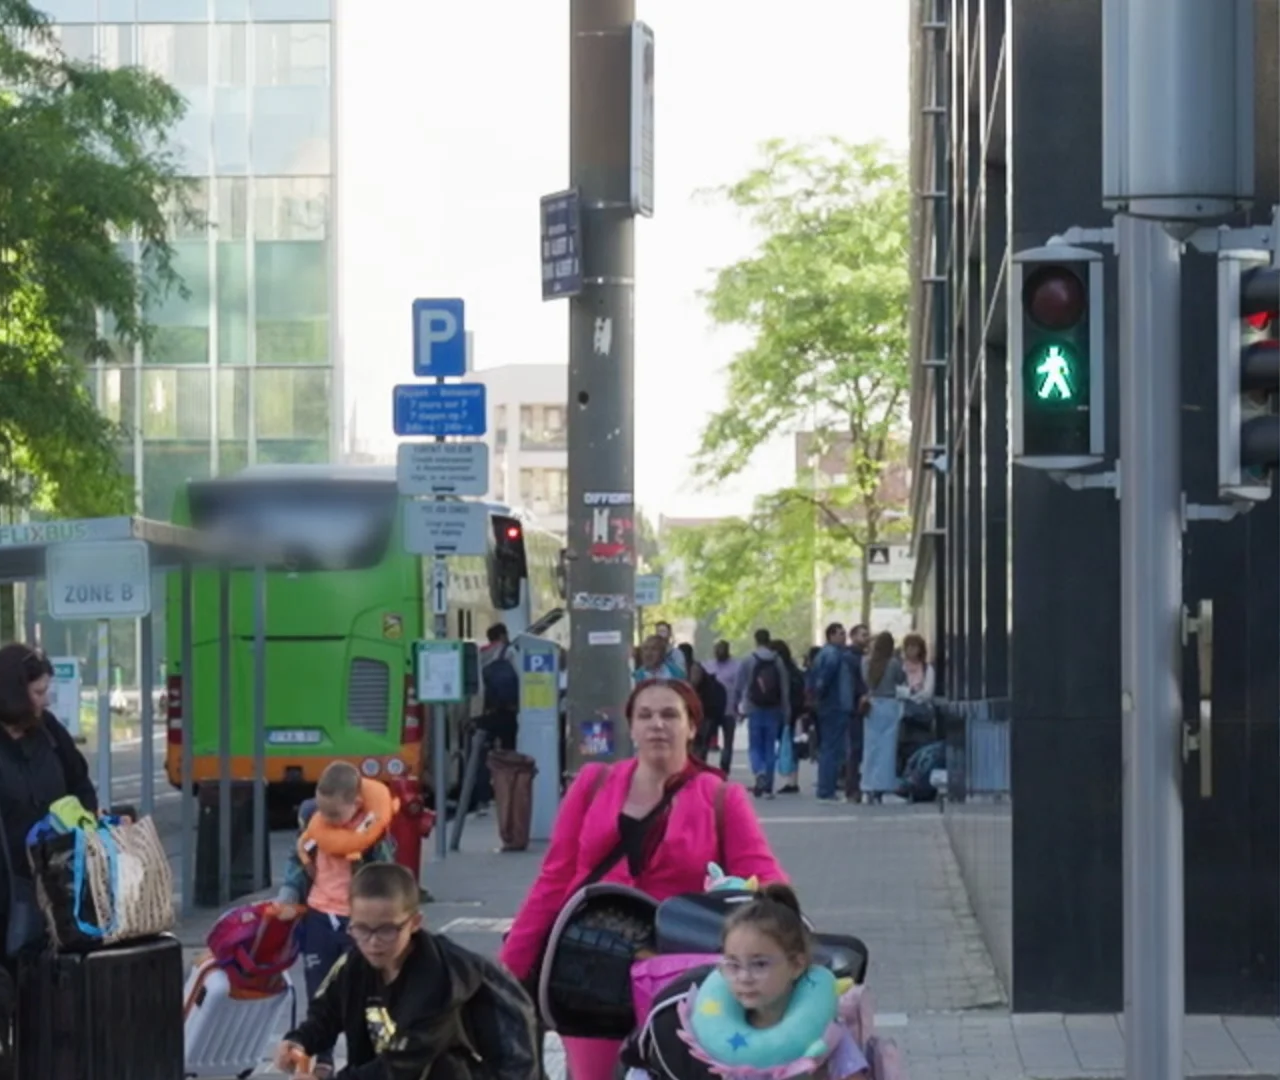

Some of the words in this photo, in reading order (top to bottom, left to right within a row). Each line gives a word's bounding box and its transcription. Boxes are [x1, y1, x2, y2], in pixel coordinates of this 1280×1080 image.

[420, 310, 456, 365] P
[64, 585, 114, 604] ZONE
[122, 583, 133, 601] B
